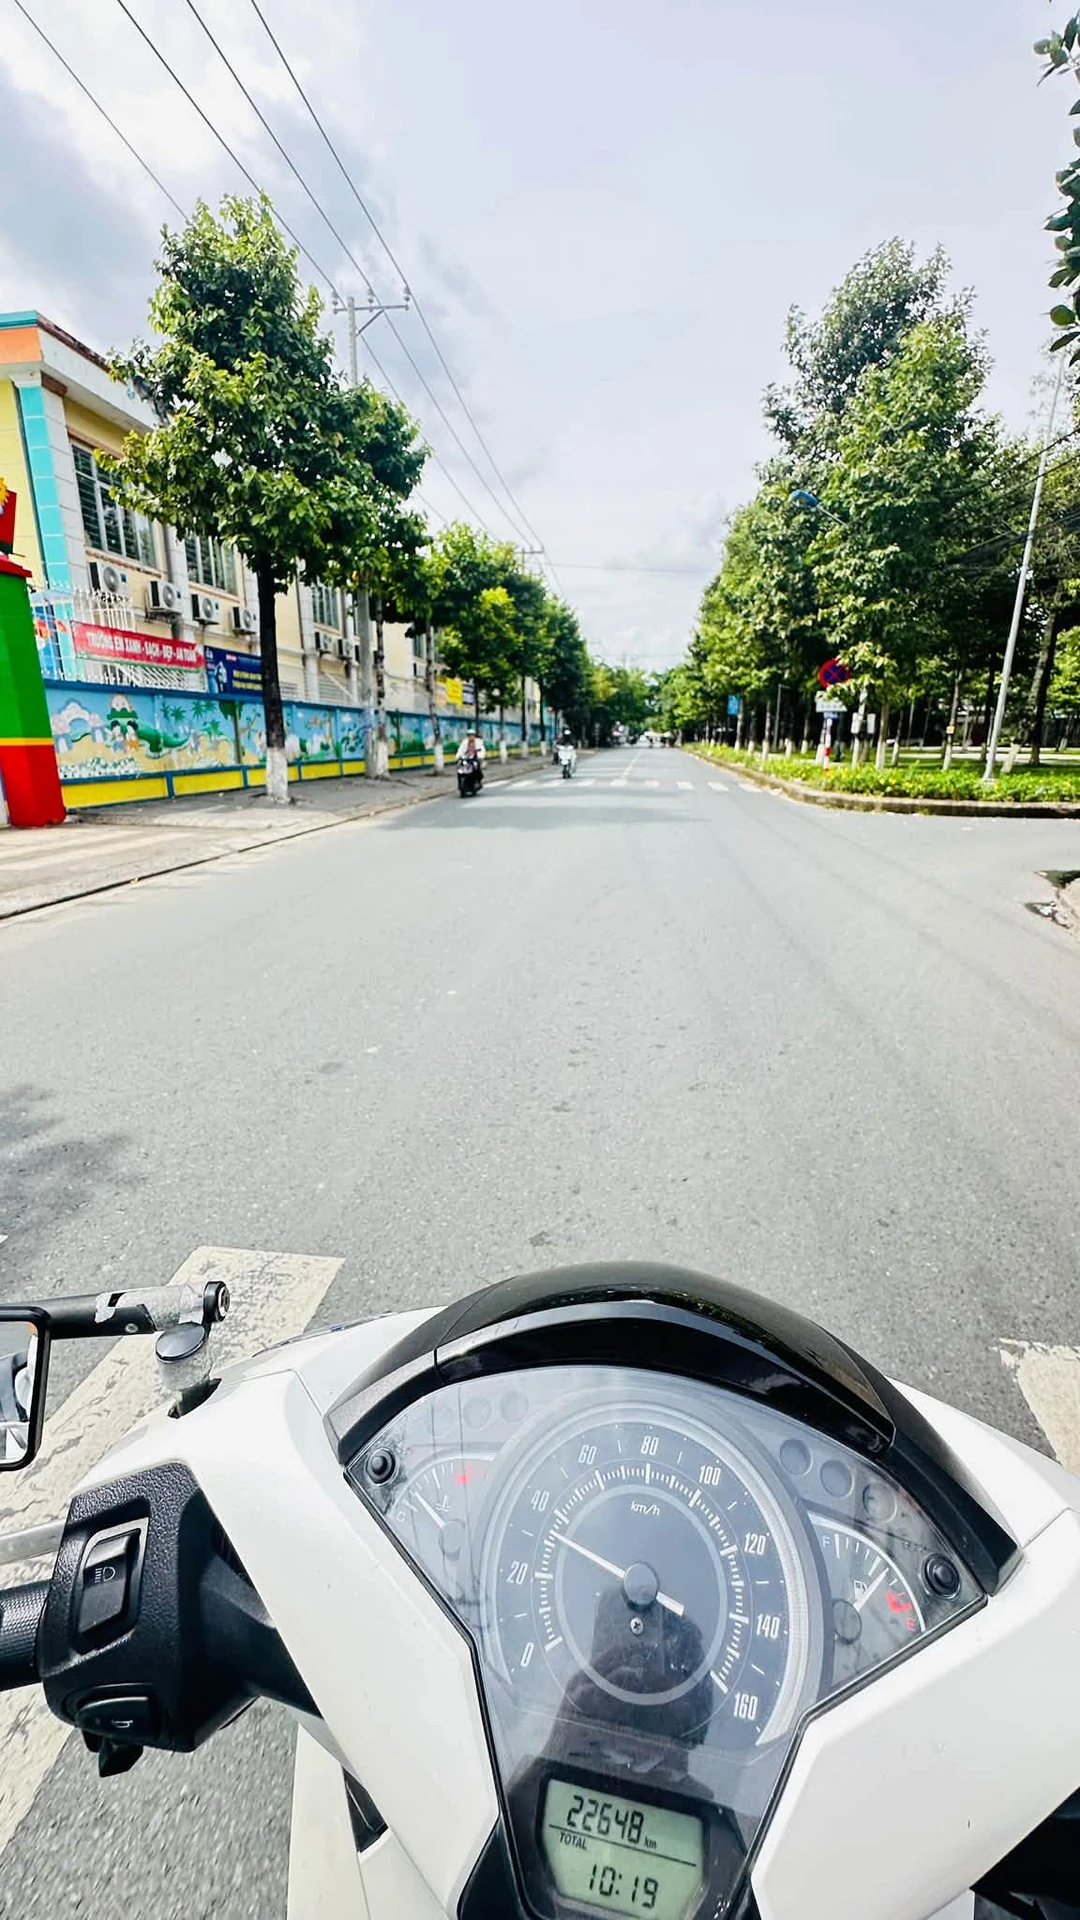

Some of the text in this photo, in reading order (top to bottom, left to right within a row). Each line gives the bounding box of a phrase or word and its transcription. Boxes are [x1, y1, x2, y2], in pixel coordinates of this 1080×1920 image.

[578, 1444, 597, 1465] 60
[641, 1436, 660, 1456] 80
[699, 1465, 722, 1486] 100
[531, 1489, 550, 1511] 40
[630, 1500, 661, 1516] km/h
[744, 1533, 767, 1555] 120
[822, 1537, 830, 1548] F
[506, 1560, 529, 1585] 20
[756, 1613, 781, 1640] 140
[906, 1617, 916, 1632] E
[520, 1642, 534, 1668] 0
[733, 1692, 758, 1721] 160
[566, 1794, 657, 1849] 22648 km
[559, 1831, 588, 1850] TOTAL
[589, 1864, 659, 1909] 10:19
